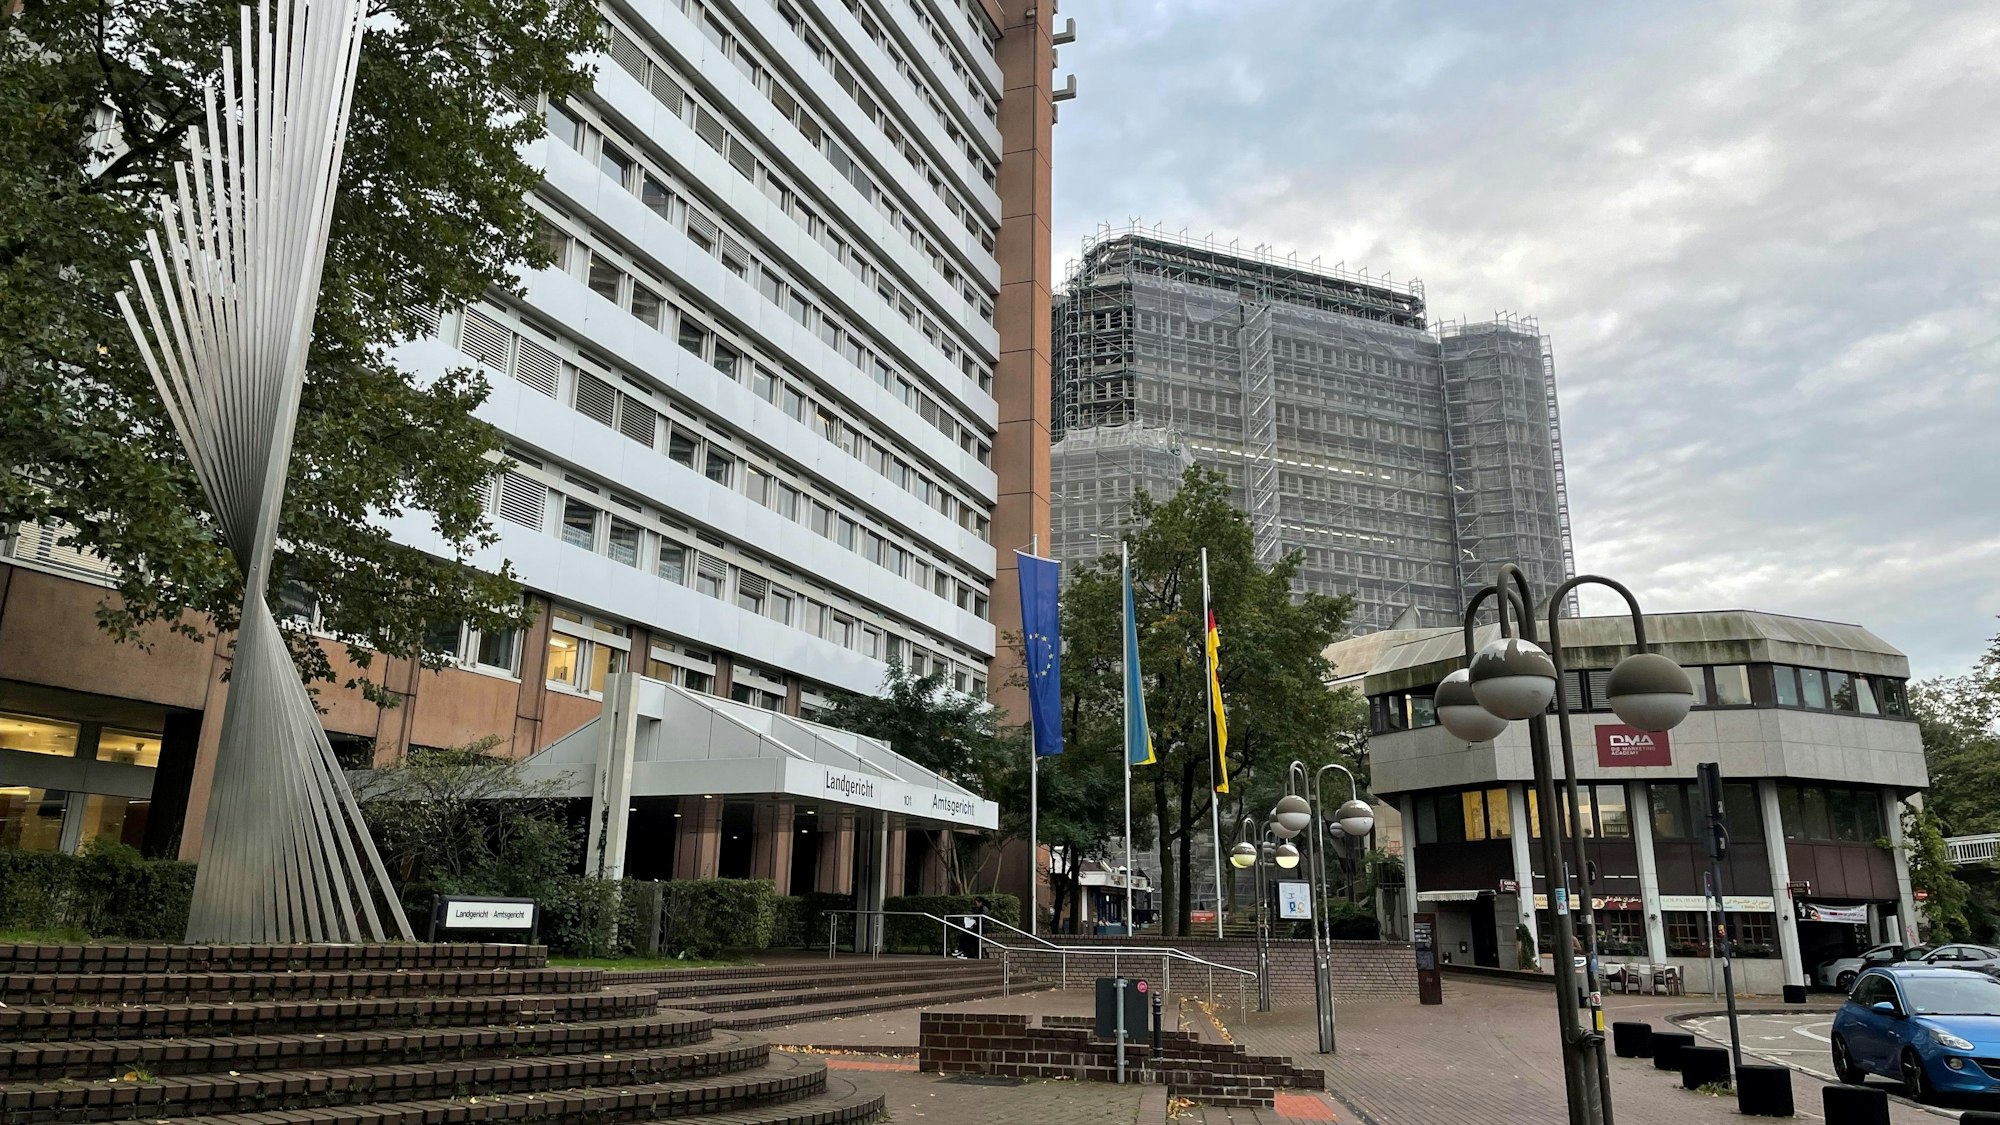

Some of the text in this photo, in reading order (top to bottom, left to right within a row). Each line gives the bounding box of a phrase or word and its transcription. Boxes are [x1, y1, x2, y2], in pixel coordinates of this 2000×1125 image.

[1609, 734, 1655, 746] DMA
[826, 771, 975, 816] Landgericht 101 Amtsgericht
[455, 909, 525, 920] Landgericht Amtsgericht
